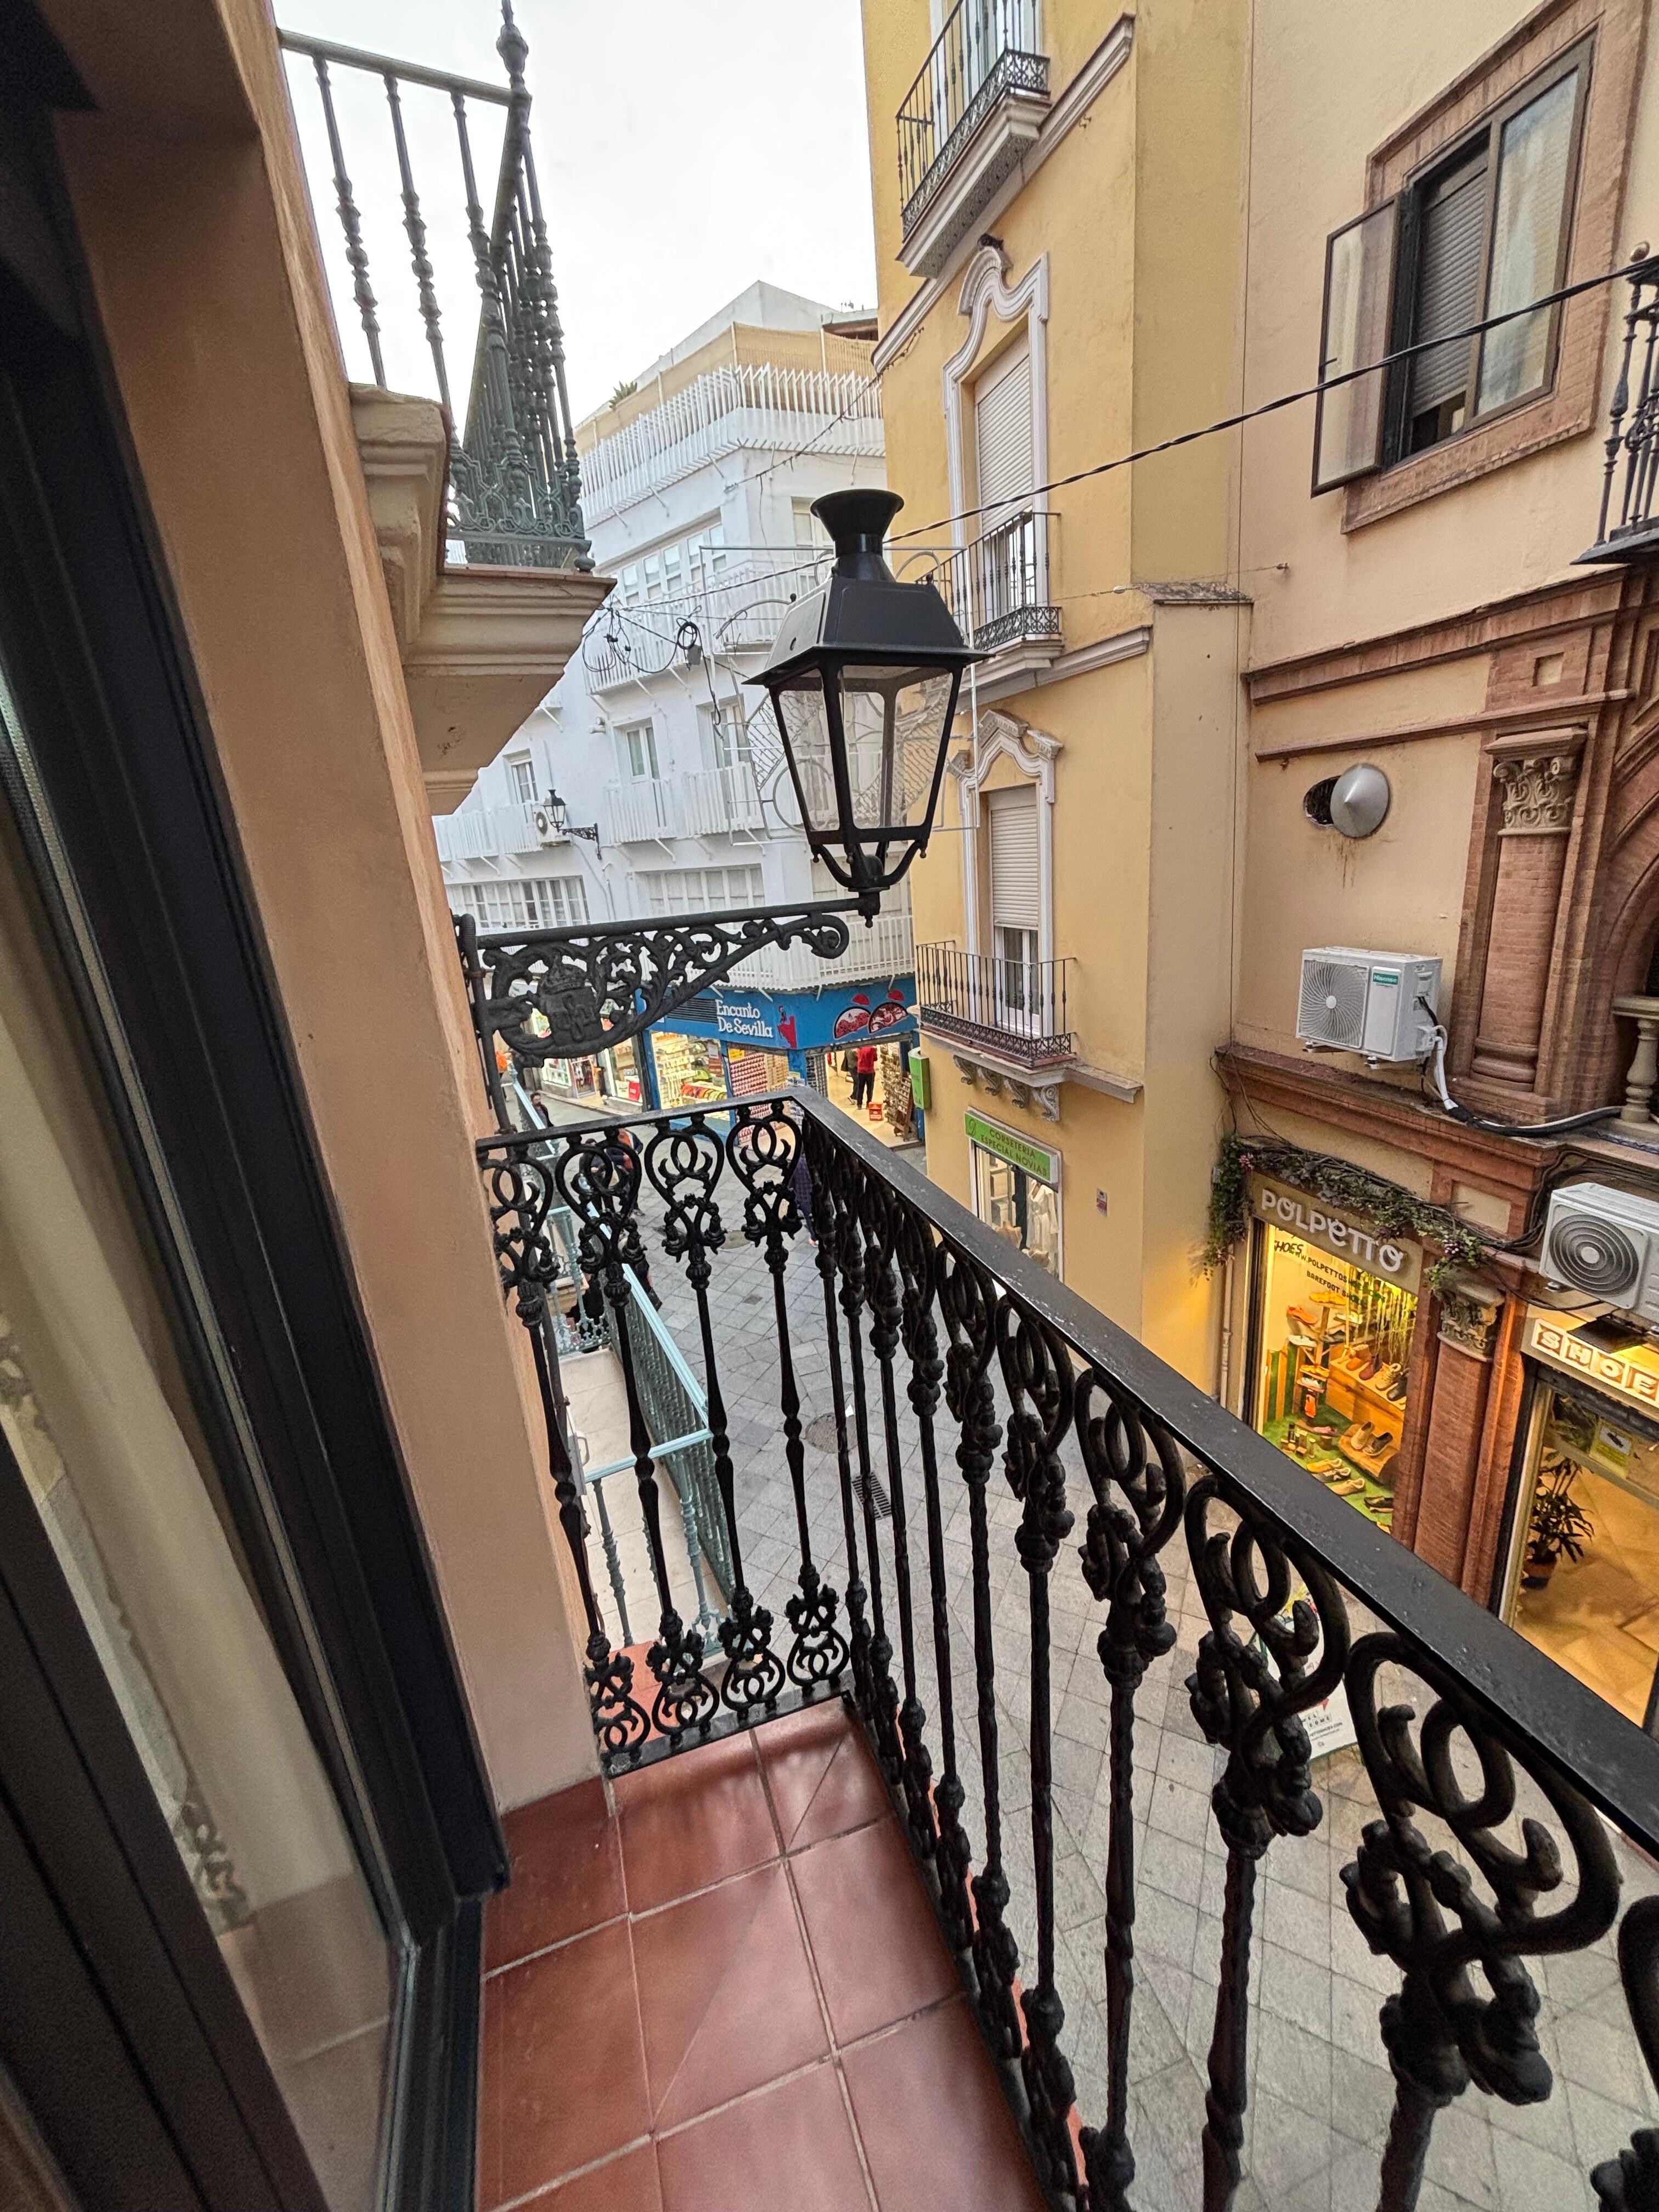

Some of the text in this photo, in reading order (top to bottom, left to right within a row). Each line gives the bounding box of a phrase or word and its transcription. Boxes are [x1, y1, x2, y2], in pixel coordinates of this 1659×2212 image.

[715, 999, 760, 1019] Encanto
[717, 1016, 774, 1038] De Sevilla
[981, 1135, 1047, 1177] ESPECIAL NOVIAS
[1306, 1270, 1340, 1293] BAREFOOT
